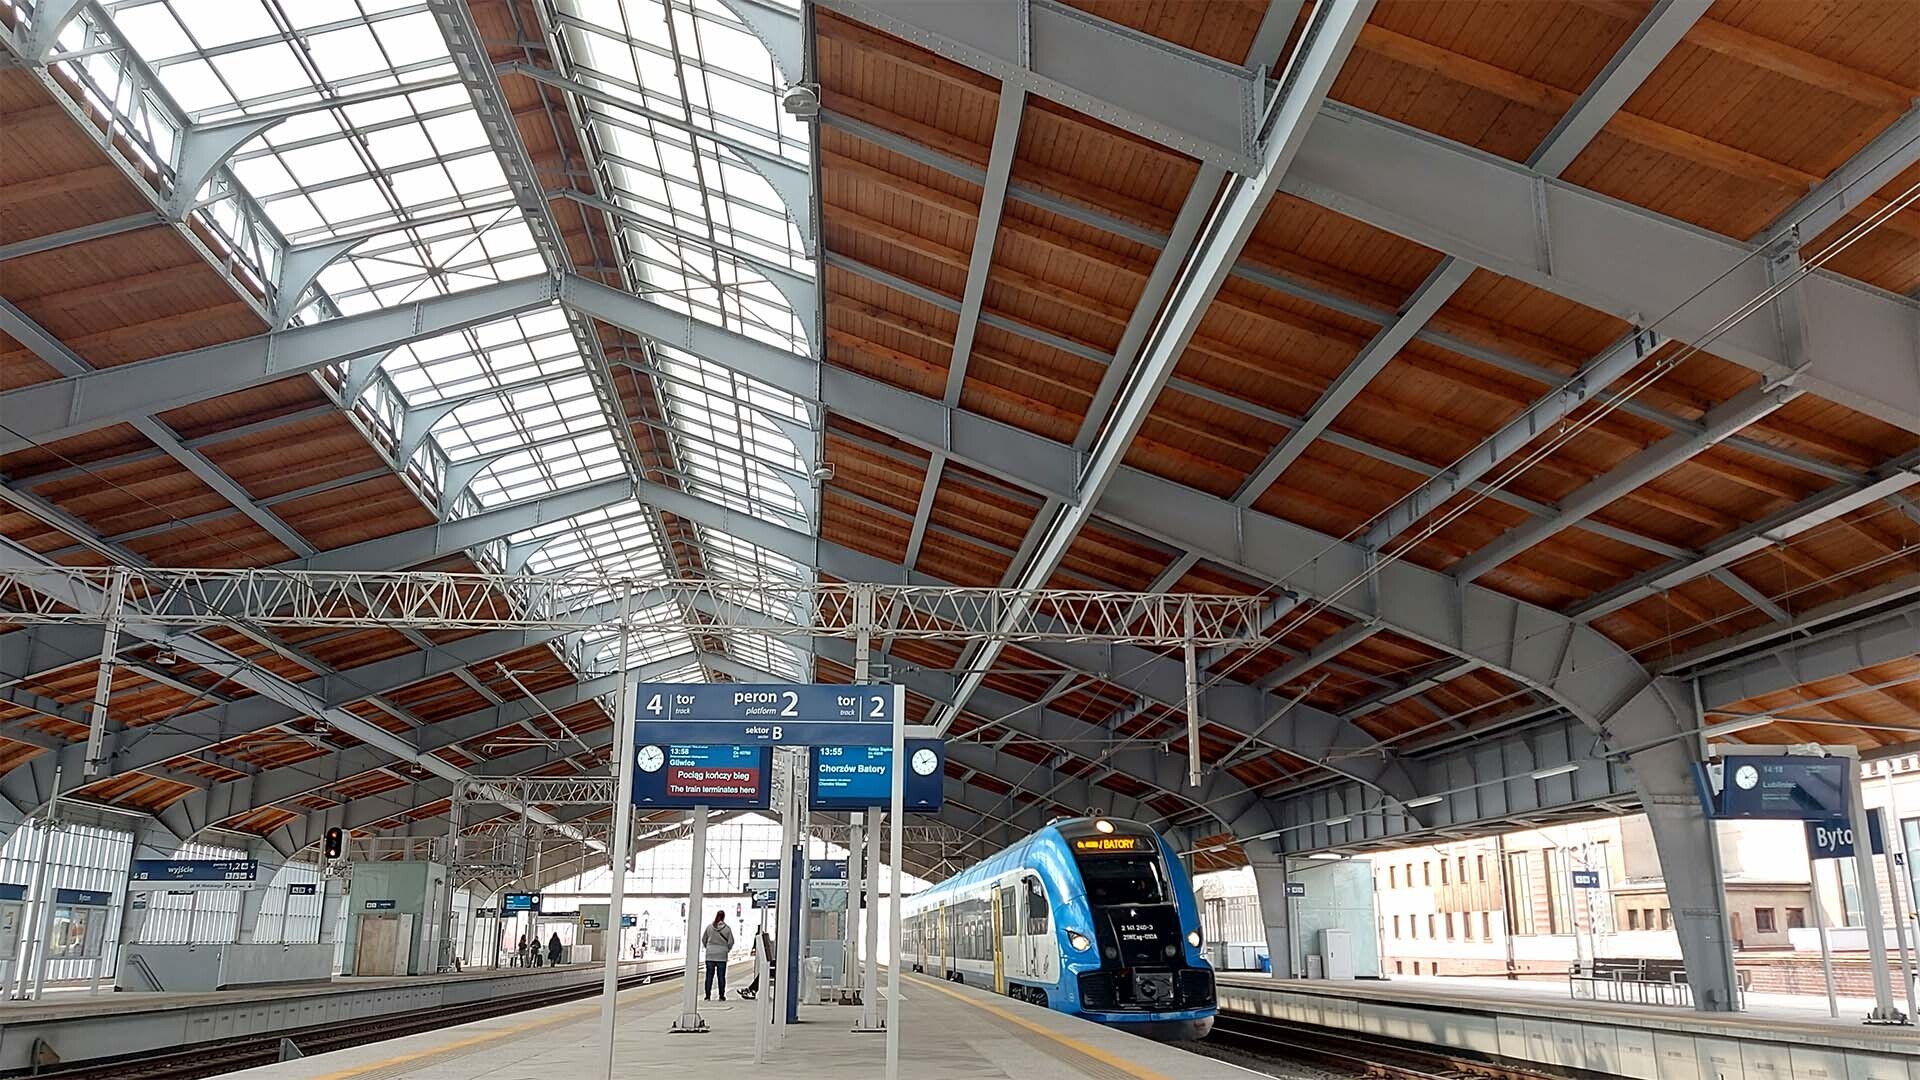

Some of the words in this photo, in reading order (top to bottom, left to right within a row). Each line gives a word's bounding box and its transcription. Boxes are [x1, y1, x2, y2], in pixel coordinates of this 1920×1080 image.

[646, 694, 663, 715] 4
[676, 694, 695, 705] tor
[734, 692, 777, 706] peron
[780, 691, 799, 717] 2
[837, 695, 856, 706] tor
[869, 696, 885, 718] 2
[745, 707, 777, 716] platform
[745, 726, 769, 735] sektor
[772, 726, 783, 740] B
[820, 747, 843, 756] 13:55
[669, 759, 696, 767] Gliwice
[819, 763, 856, 773] Chorzów
[857, 764, 886, 775] Batory
[677, 770, 704, 781] Pociąg
[705, 771, 732, 781] kończy
[733, 771, 750, 781] bieg
[670, 785, 684, 793] The
[685, 785, 701, 793] train
[702, 785, 738, 794] terminates
[739, 786, 756, 794] here
[1103, 839, 1134, 849] BATORY
[1815, 827, 1854, 852] Byto
[167, 865, 195, 874] wyjście
[228, 862, 240, 871] 1,2
